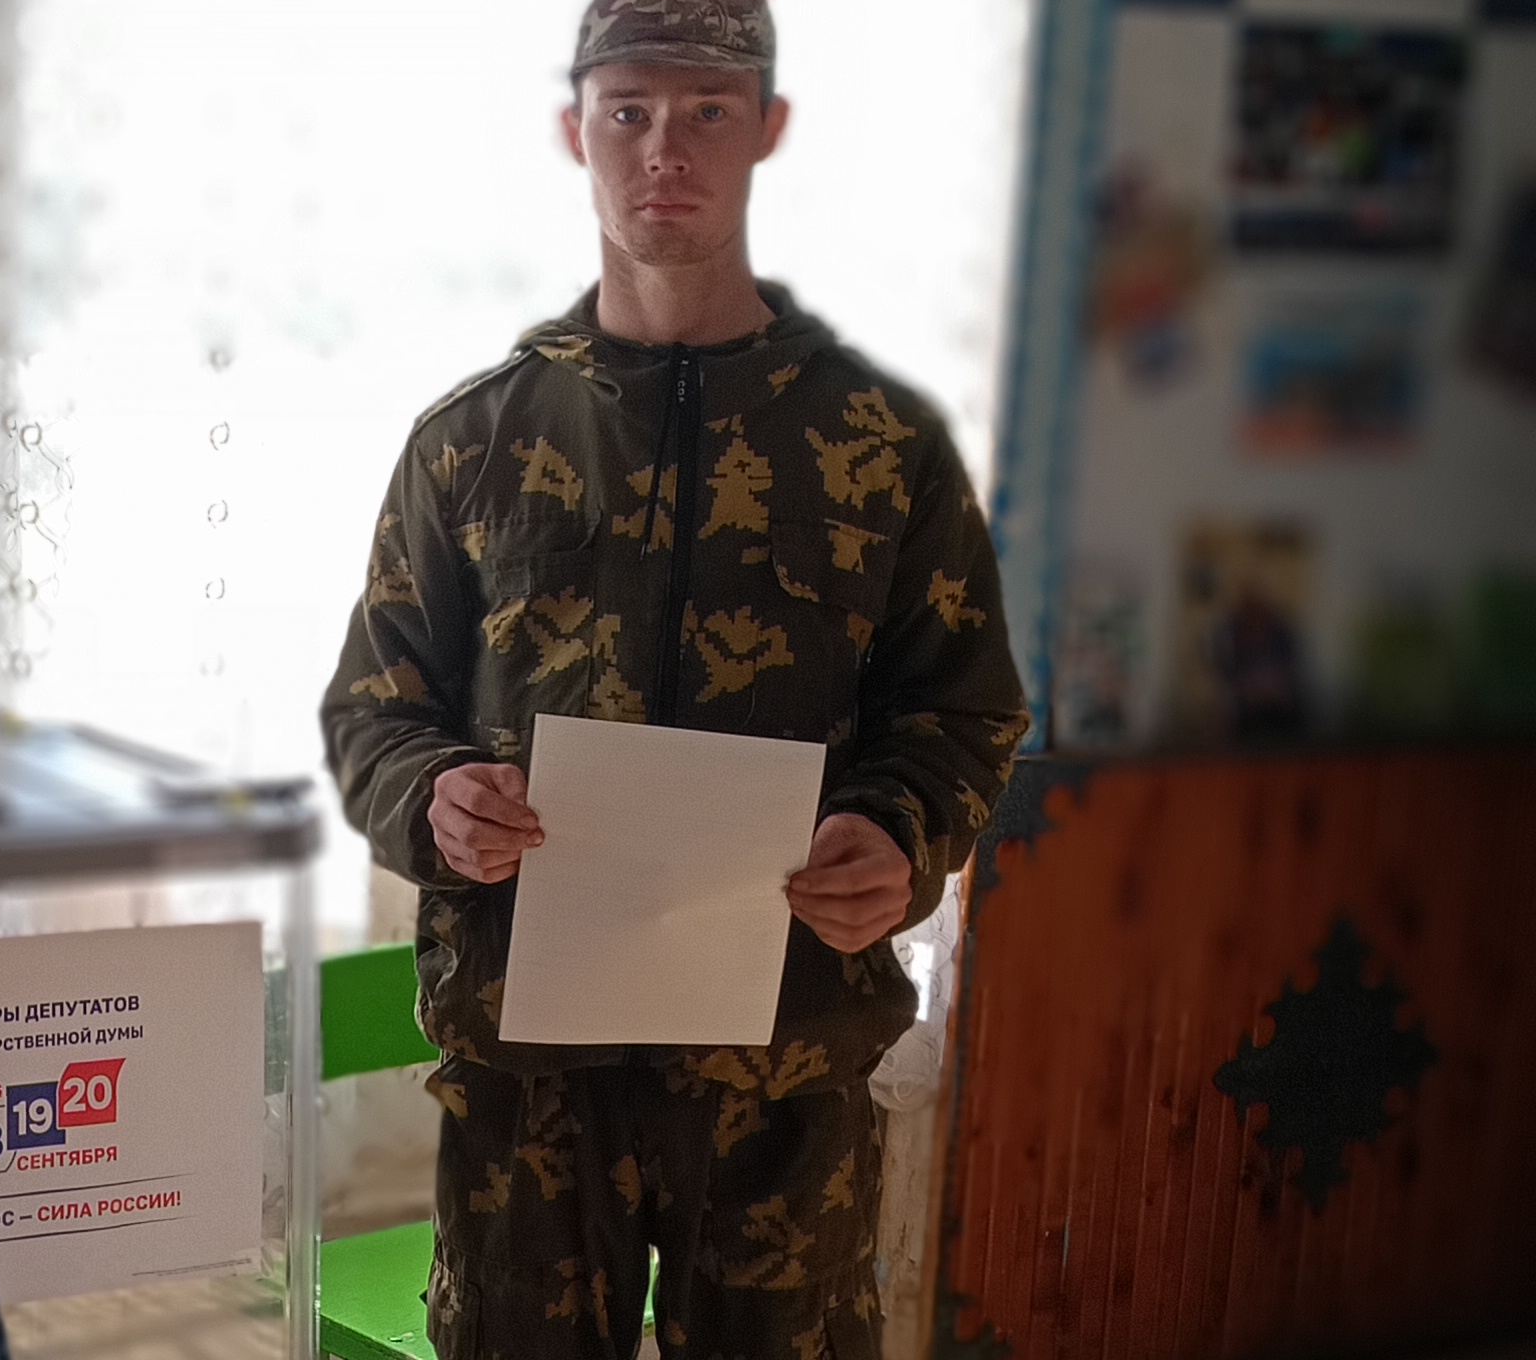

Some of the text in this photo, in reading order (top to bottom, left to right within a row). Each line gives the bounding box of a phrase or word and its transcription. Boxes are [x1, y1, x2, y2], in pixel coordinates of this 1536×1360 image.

[25, 995, 140, 1023] ДЕПУТАТОВ
[95, 1025, 144, 1046] ДУМЫ
[12, 1098, 53, 1136] 19
[63, 1074, 113, 1113] 20
[16, 1146, 118, 1171] СЕНТЯБРЯ
[37, 1203, 92, 1223] СИЛА
[97, 1191, 181, 1216] РОССИИ!
